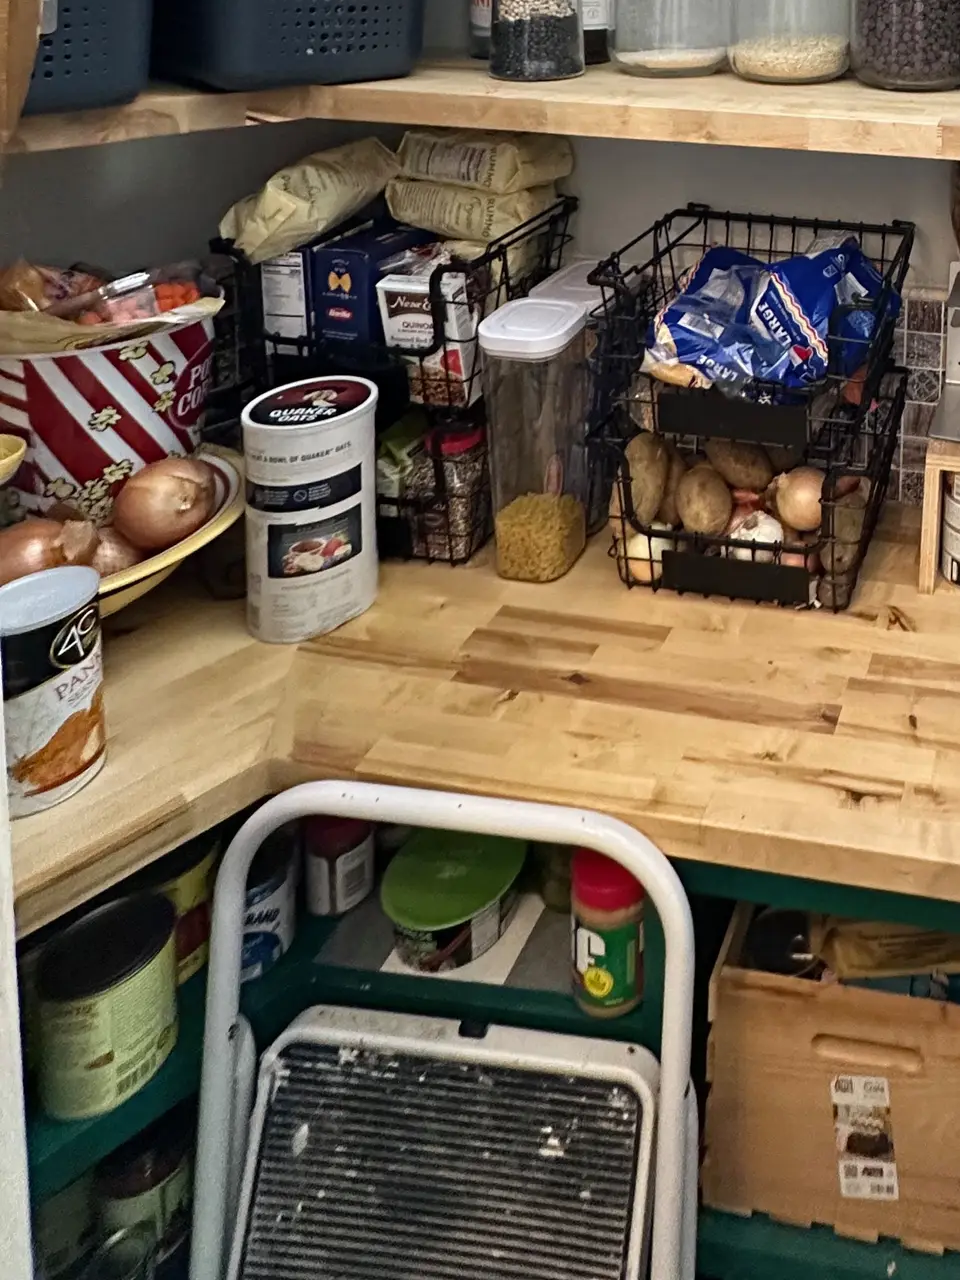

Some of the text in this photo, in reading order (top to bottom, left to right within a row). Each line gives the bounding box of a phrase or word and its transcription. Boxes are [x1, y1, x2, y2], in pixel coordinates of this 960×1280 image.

[757, 301, 793, 347] LARGE
[269, 406, 337, 417] QUAKER
[277, 413, 318, 422] OATS
[289, 455, 299, 463] OF
[57, 608, 98, 658] 4C
